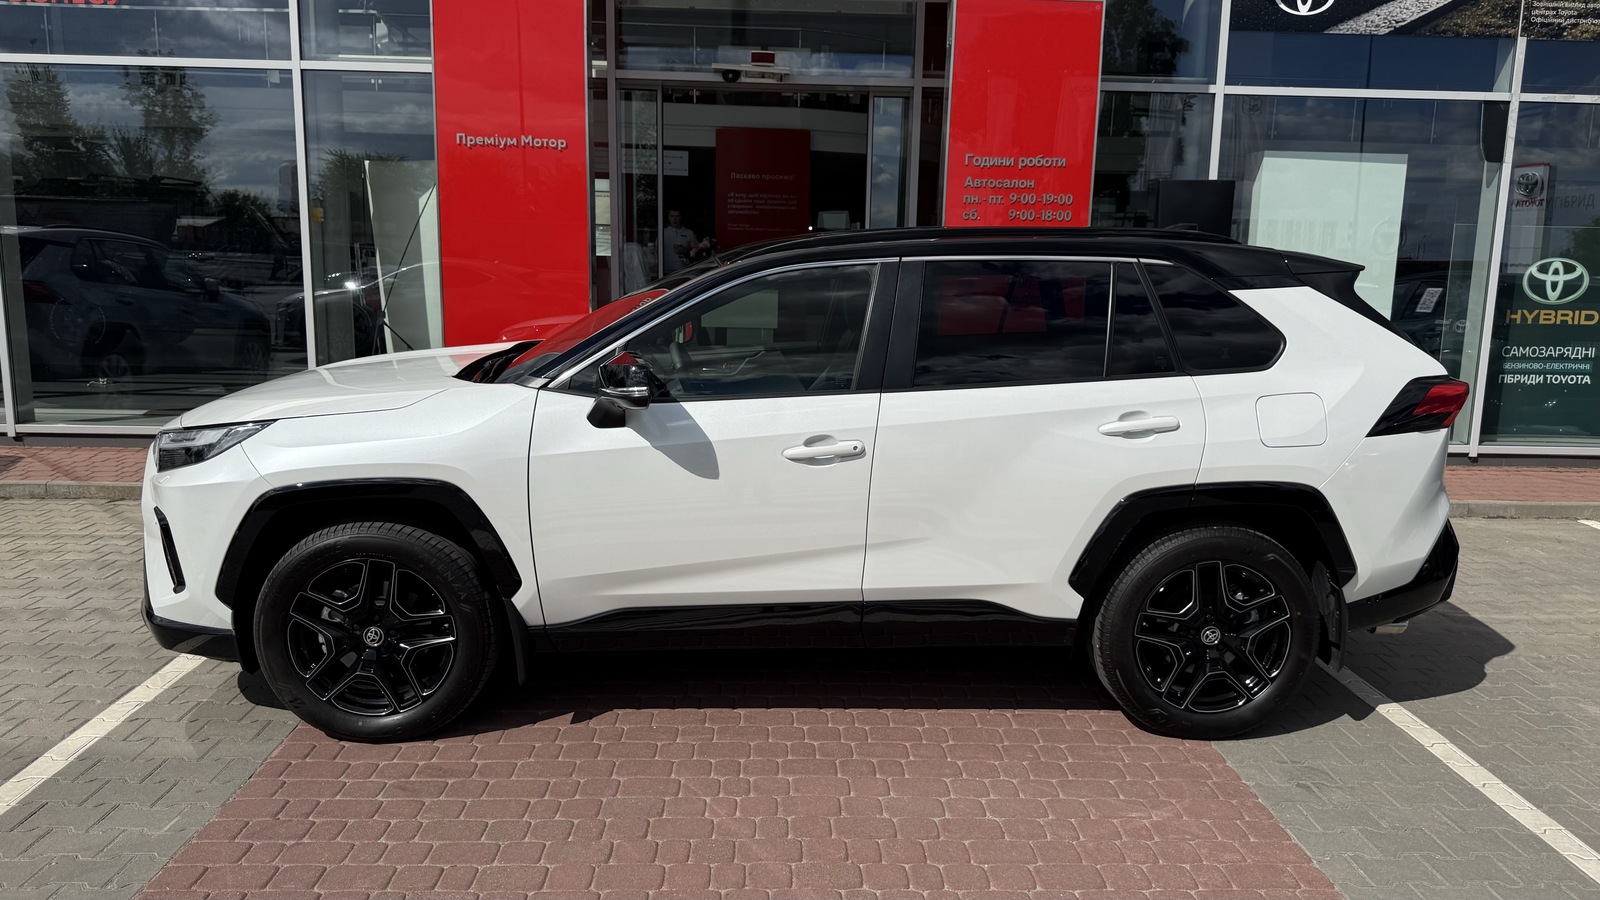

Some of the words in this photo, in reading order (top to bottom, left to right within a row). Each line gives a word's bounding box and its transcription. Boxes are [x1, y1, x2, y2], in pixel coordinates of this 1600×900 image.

[455, 133, 517, 148] Преміум
[521, 135, 567, 150] Мотор
[965, 153, 1014, 167] Години
[1018, 155, 1066, 169] роботи
[964, 176, 1035, 189] Автосалон
[1009, 193, 1073, 205] 9:00-19:00
[1554, 194, 1595, 210] ГІБРИД
[962, 209, 981, 220] сб.
[1008, 209, 1072, 221] 9:00-18:00
[1505, 309, 1600, 325] HYBRID
[1502, 346, 1596, 359] САМОЗАРЯДНІ
[1502, 362, 1590, 370] БЕНЗИНОВО-ЕЛЕКТРИЧНІ
[1498, 374, 1544, 385] ГІБРИДИ
[1545, 375, 1591, 385] TOYOTA
